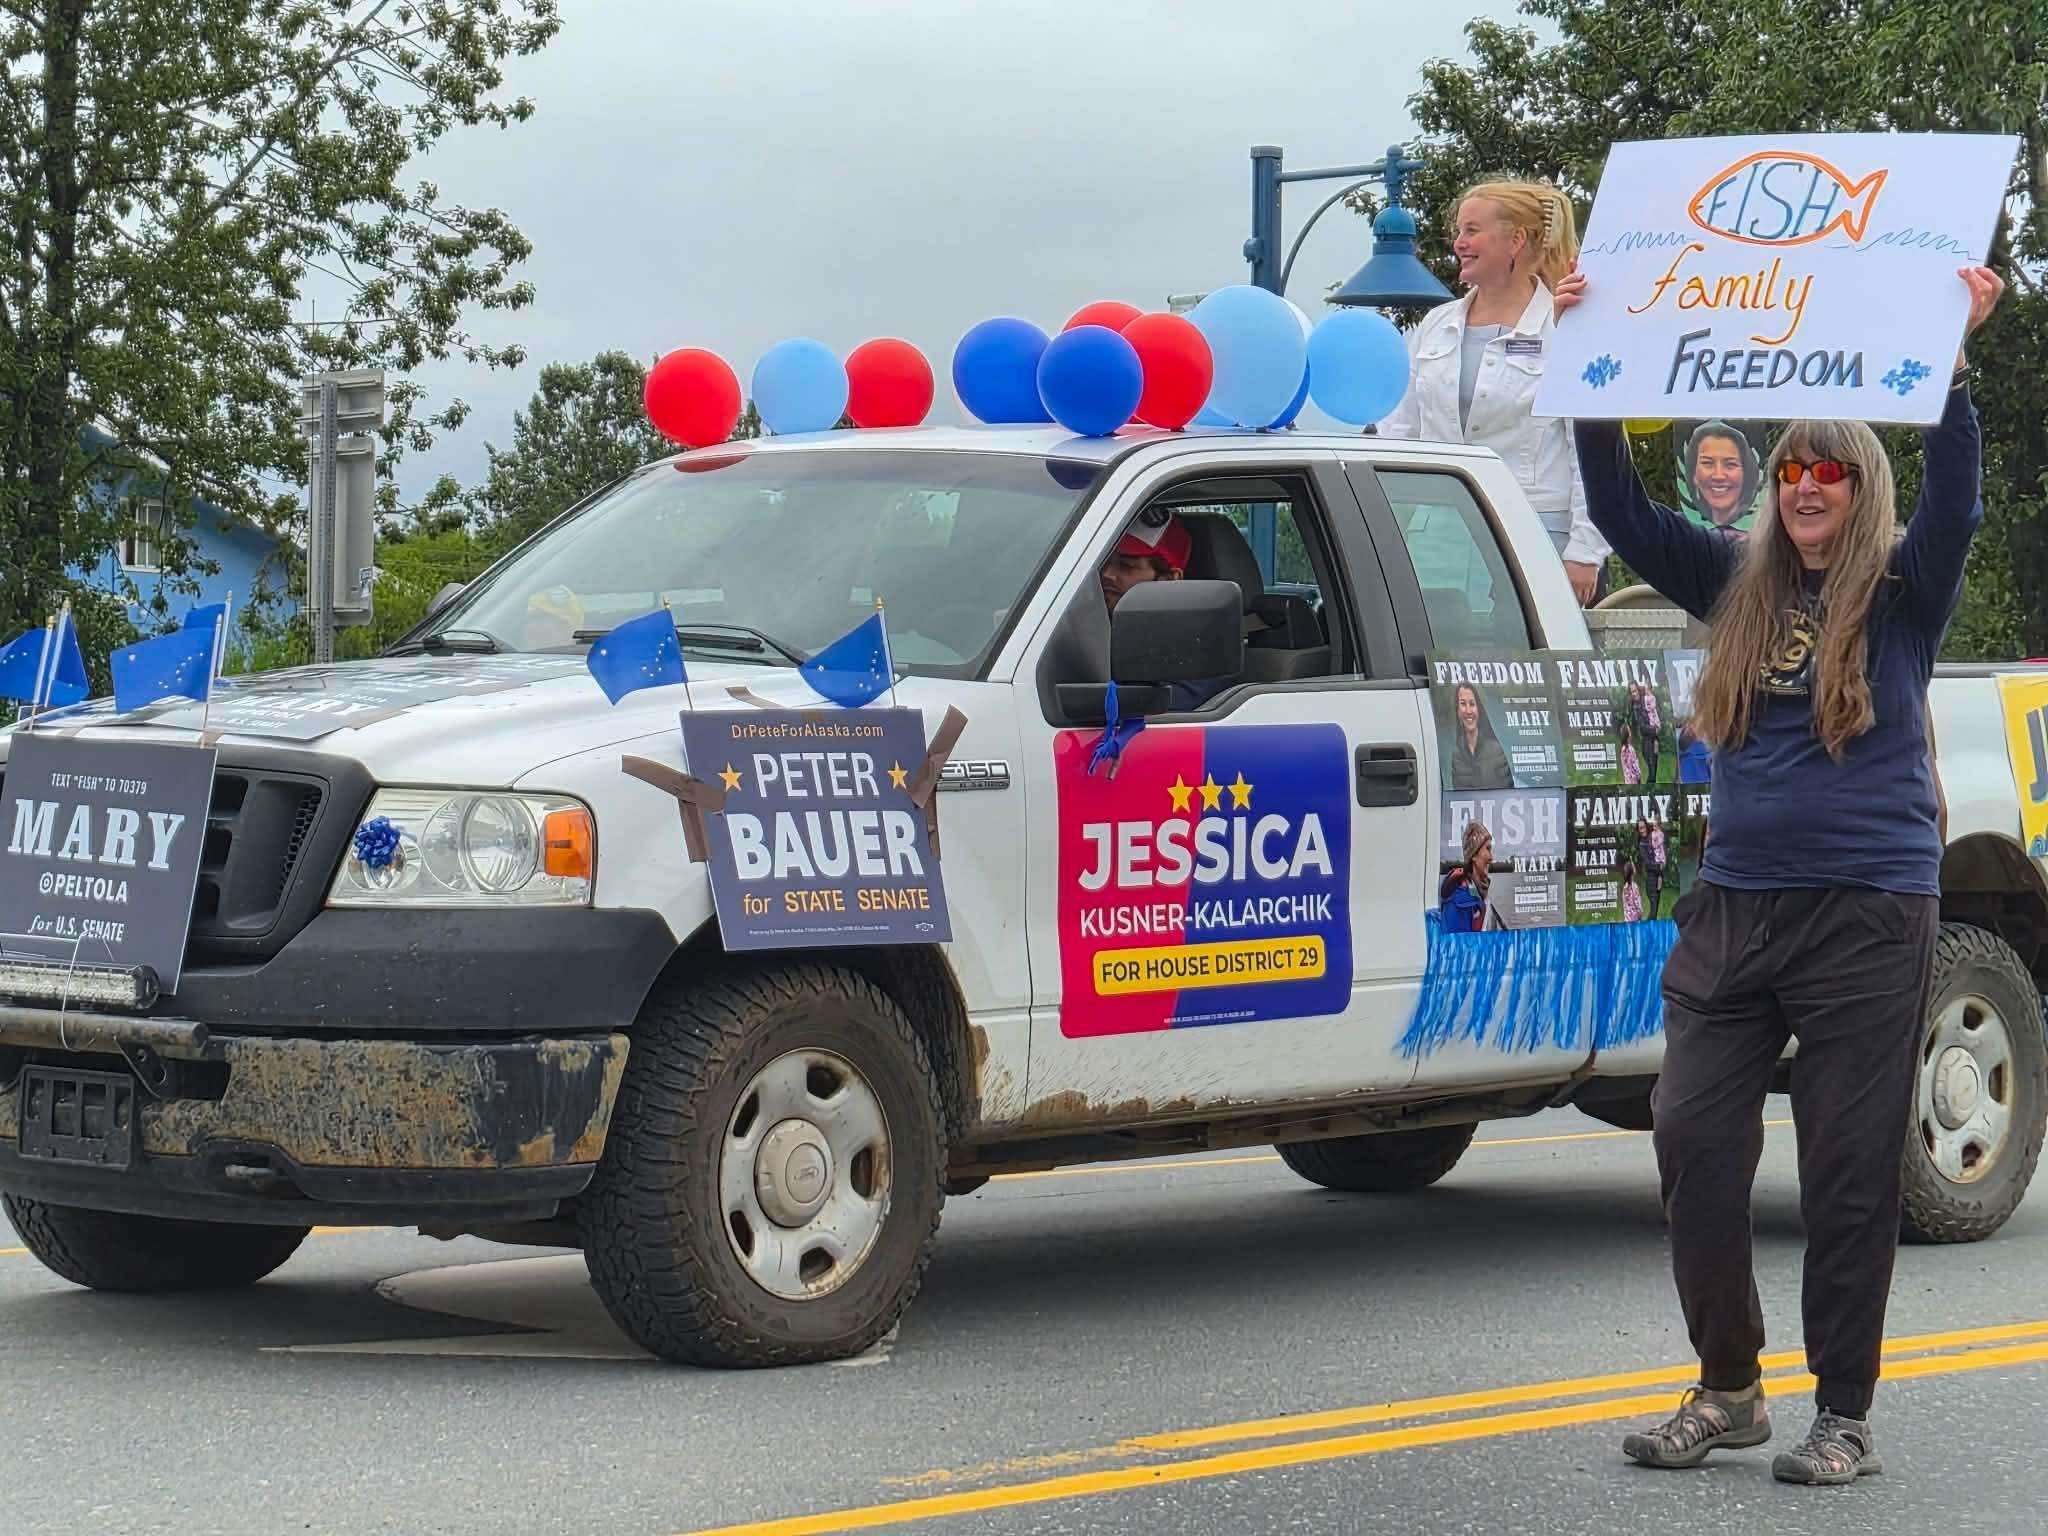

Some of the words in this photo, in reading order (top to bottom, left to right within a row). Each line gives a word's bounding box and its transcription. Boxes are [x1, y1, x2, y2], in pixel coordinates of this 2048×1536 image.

[1706, 160, 1840, 240] FISH
[1627, 242, 1815, 345] family
[1663, 328, 1865, 395] FREEDOM
[1434, 661, 1545, 685] FREEDOM
[1557, 660, 1658, 688] FAMILY
[731, 723, 884, 739] DrPeteForAlaska.com
[1505, 710, 1550, 727] MARY
[1568, 711, 1612, 728] MARY
[51, 773, 71, 788] TEXT
[105, 778, 116, 792] TO
[119, 779, 147, 795] 70379
[752, 752, 880, 798] PETER
[1448, 797, 1561, 848] FISH
[1574, 795, 1671, 826] FAMILY
[8, 799, 185, 869] MARY
[726, 810, 925, 881] BAUER
[1078, 812, 1334, 890] JESSICA
[1514, 855, 1557, 873] MARY
[1575, 848, 1617, 867] MARY
[39, 871, 128, 903] @PELTOLA
[743, 893, 771, 915] for
[784, 890, 846, 913] STATE
[857, 888, 930, 911] SENATE
[27, 913, 53, 935] for
[56, 916, 78, 937] U.S.
[82, 918, 125, 943] SENATE
[1080, 893, 1333, 938] KUSNER-KALARCHIK
[1101, 960, 1141, 984] FOR
[1146, 955, 1210, 979] HOUSE
[1216, 949, 1294, 974] DISTRICT
[1299, 946, 1318, 967] 29
